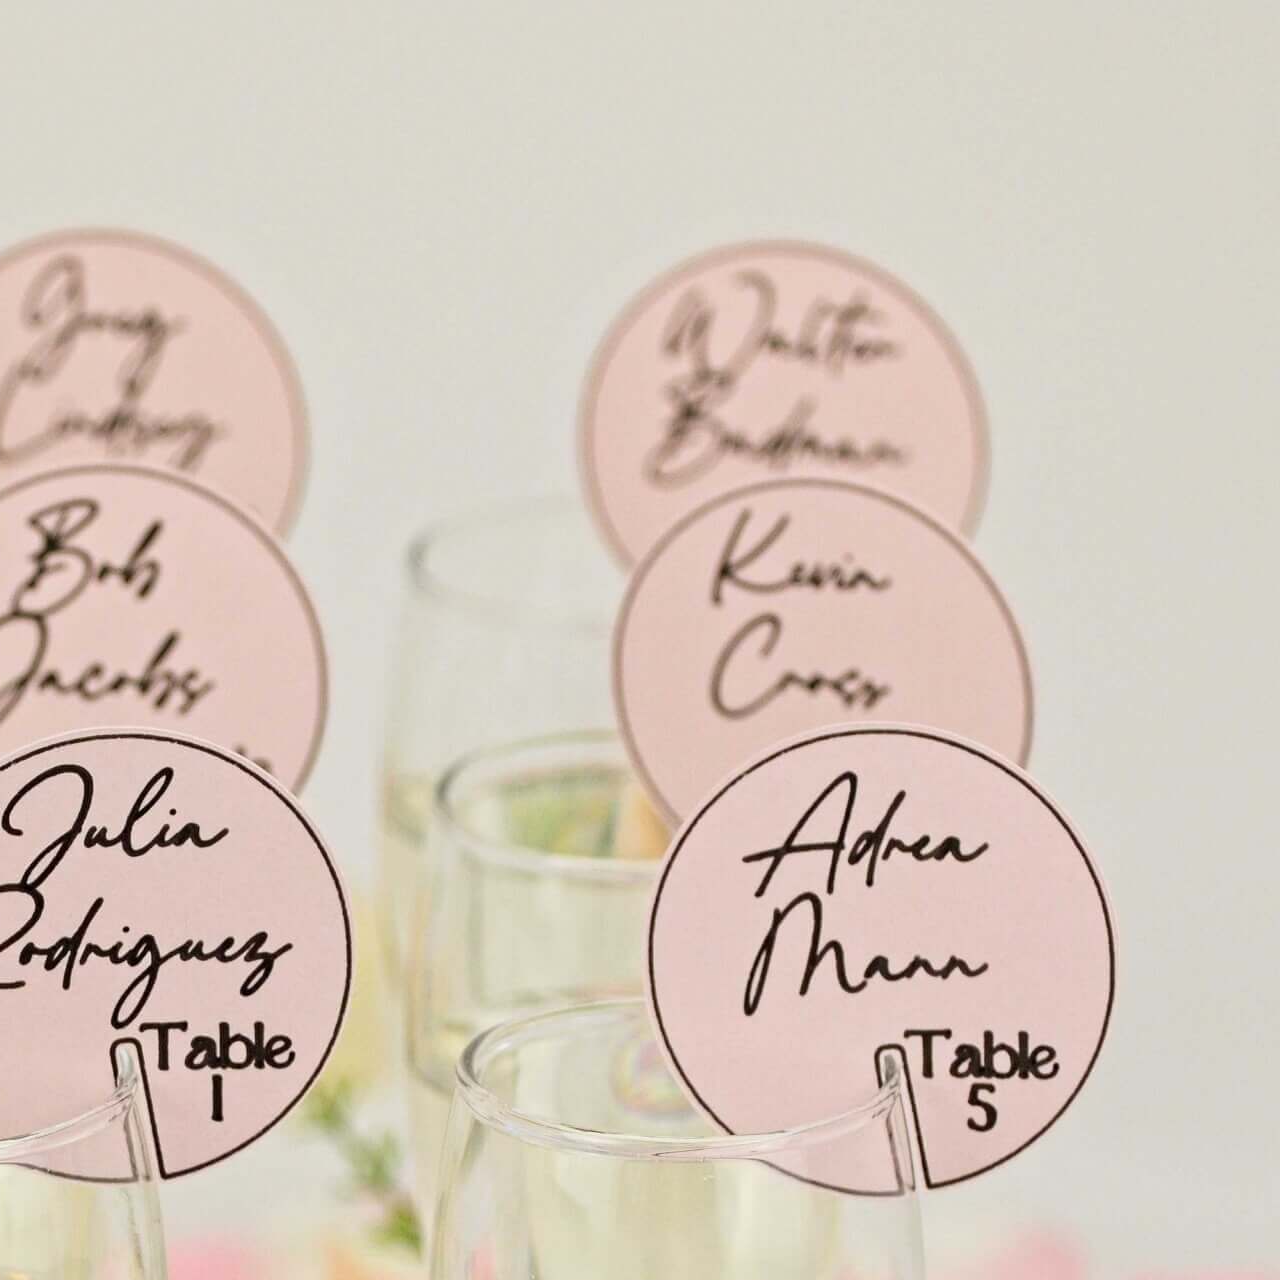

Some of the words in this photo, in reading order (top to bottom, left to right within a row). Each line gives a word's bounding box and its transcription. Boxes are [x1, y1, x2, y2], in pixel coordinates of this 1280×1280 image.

[11, 498, 163, 616] Bob
[709, 507, 892, 609] Kevin
[708, 612, 891, 721] Cross
[1, 764, 229, 889] Julia
[743, 771, 988, 898] Adrea
[743, 892, 988, 1016] Mann
[139, 1022, 296, 1070] Table
[903, 1030, 1060, 1080] Table
[966, 1083, 998, 1131] 5
